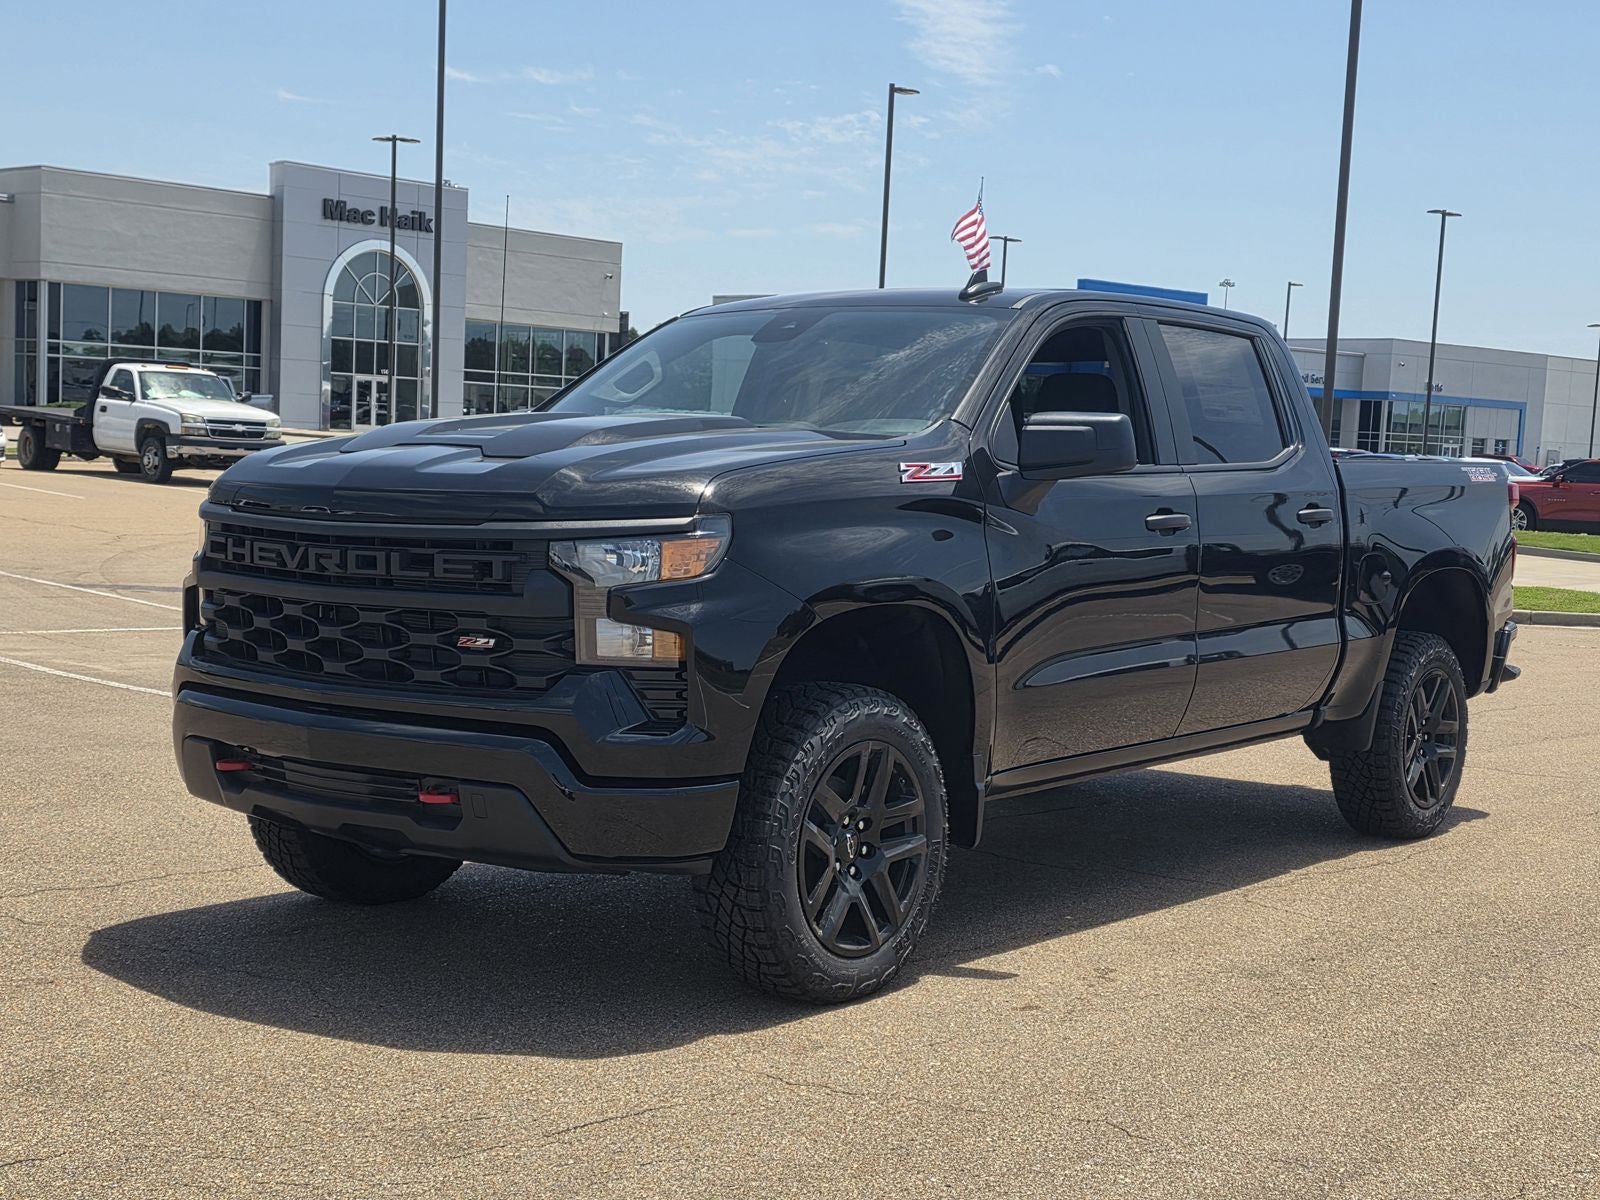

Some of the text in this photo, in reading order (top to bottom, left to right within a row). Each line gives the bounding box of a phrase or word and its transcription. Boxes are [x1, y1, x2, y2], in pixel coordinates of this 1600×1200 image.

[323, 198, 434, 233] Mac Haik
[899, 461, 963, 483] Z71
[204, 536, 520, 580] CHEVROLET
